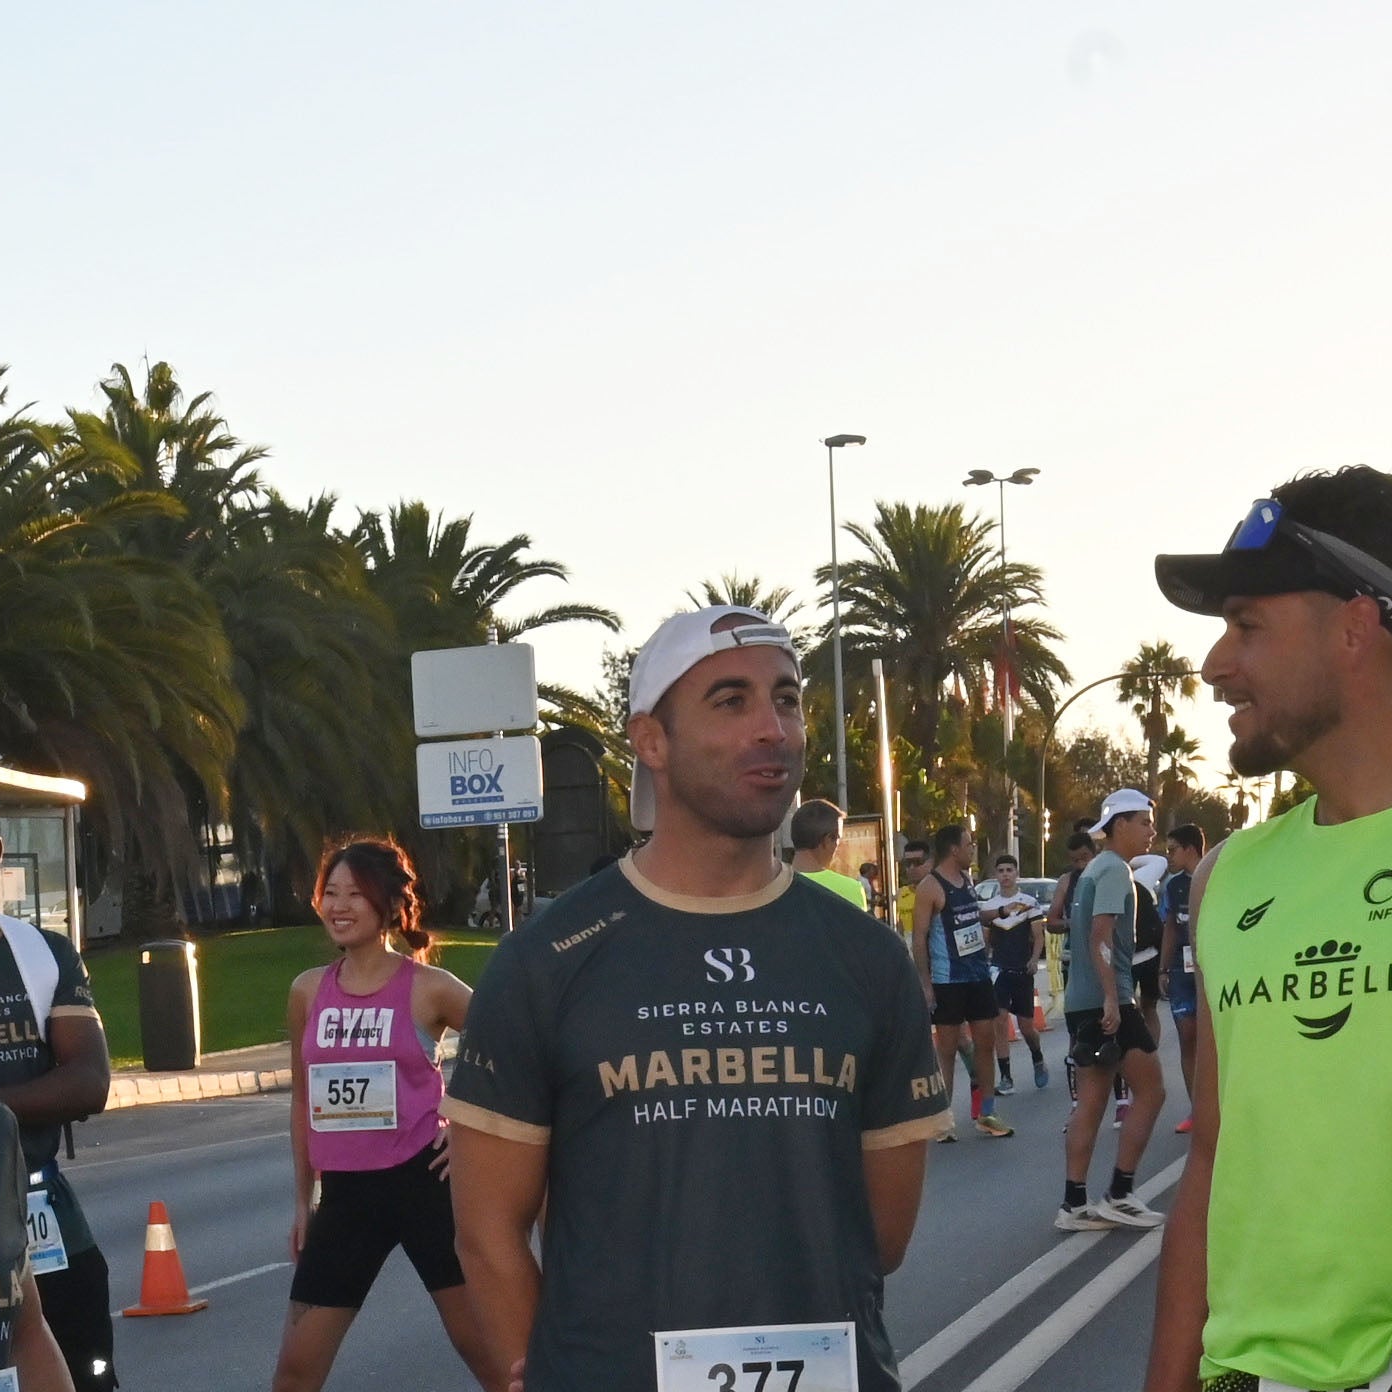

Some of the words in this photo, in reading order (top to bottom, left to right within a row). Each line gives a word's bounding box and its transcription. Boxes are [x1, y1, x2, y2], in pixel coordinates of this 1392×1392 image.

[449, 749, 493, 774] INFO
[450, 764, 504, 796] BOX
[552, 918, 607, 953] luanvi
[637, 1001, 725, 1020] SIERRA
[736, 999, 828, 1016] BLANCA
[316, 1007, 394, 1049] GYM
[682, 1020, 788, 1036] ESTATES
[598, 1047, 856, 1099] MARBELLA
[328, 1078, 370, 1105] 557
[633, 1098, 697, 1125] HALF
[707, 1096, 839, 1121] MARATHON
